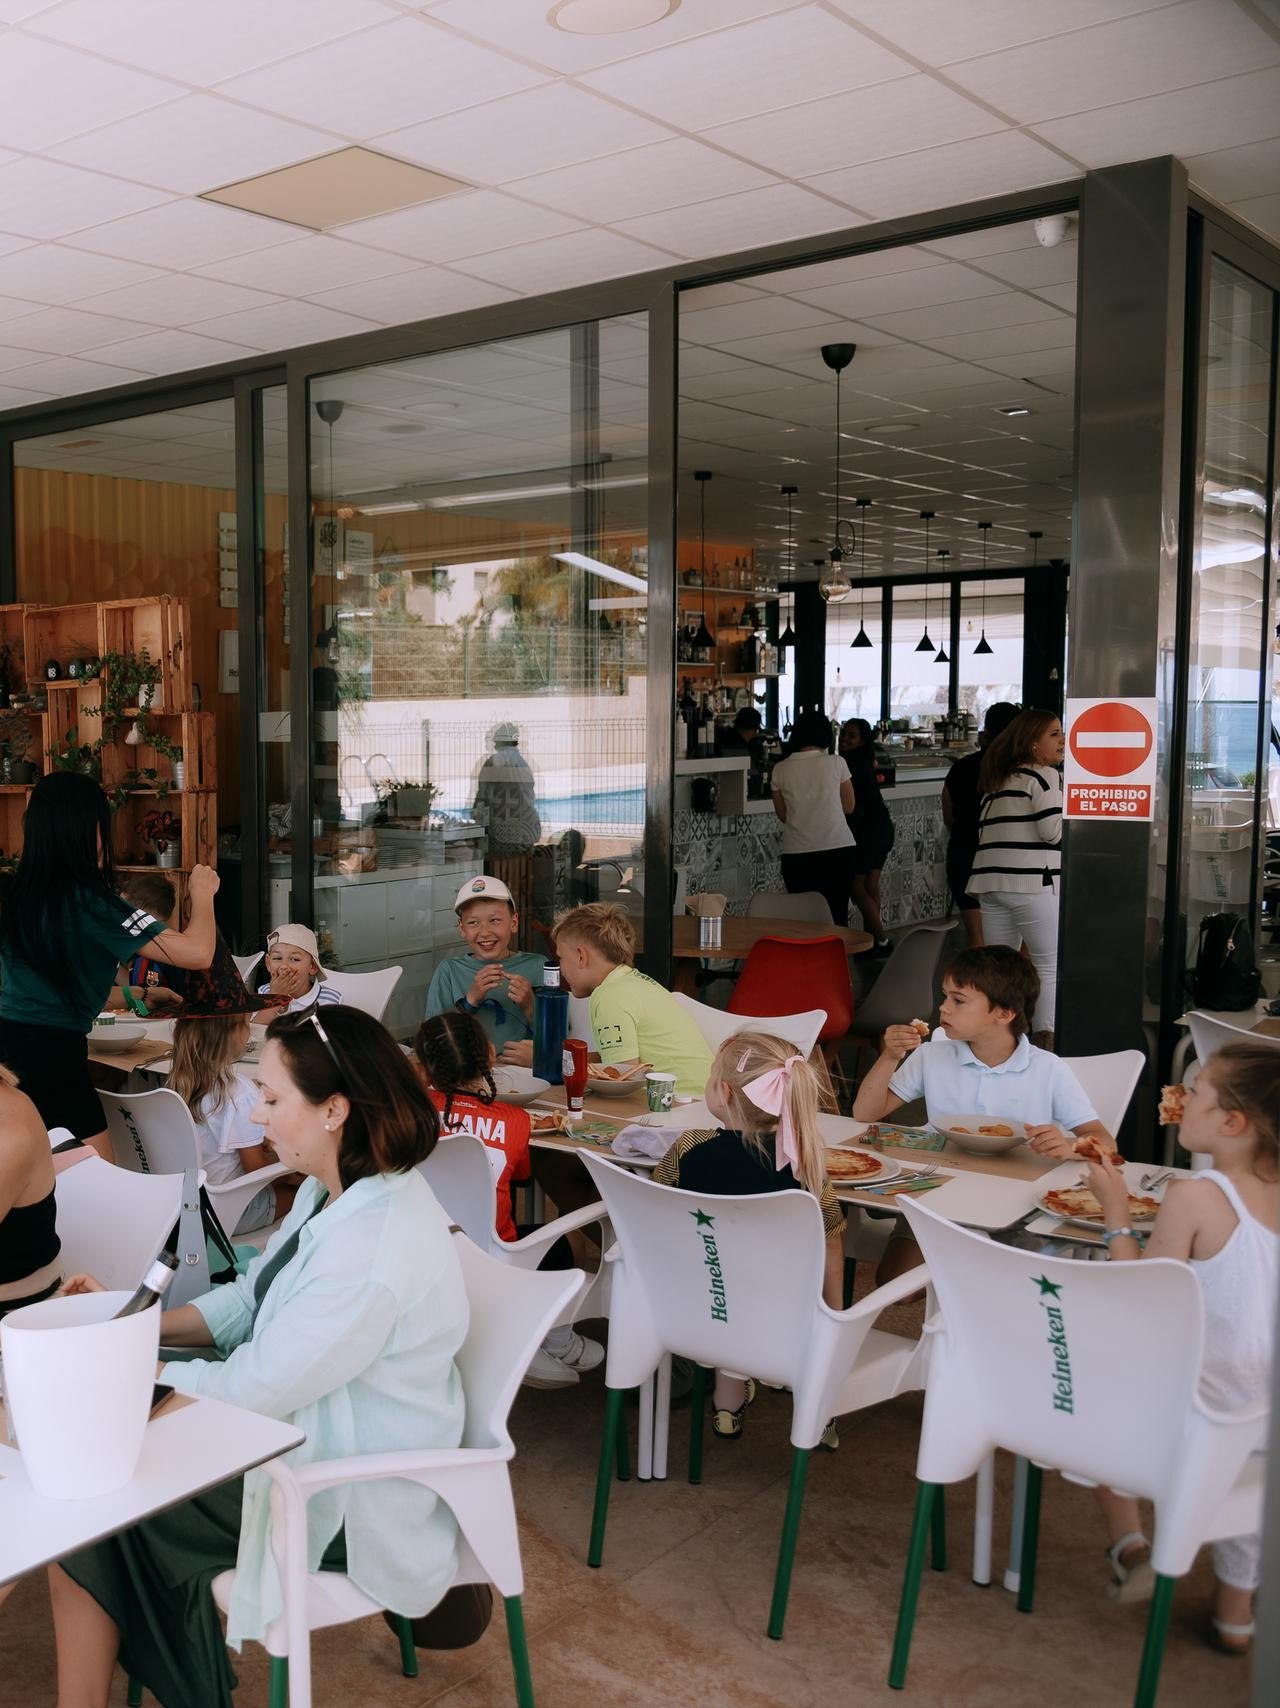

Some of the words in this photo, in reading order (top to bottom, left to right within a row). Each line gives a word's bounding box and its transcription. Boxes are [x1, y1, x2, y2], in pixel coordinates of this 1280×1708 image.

[1070, 788, 1148, 801] PROHIBIDO
[1079, 800, 1097, 811] EL
[1101, 801, 1138, 812] PASO
[129, 1126, 151, 1175] neken
[703, 1234, 728, 1323] Heineken
[1046, 1305, 1074, 1414] Heineken
